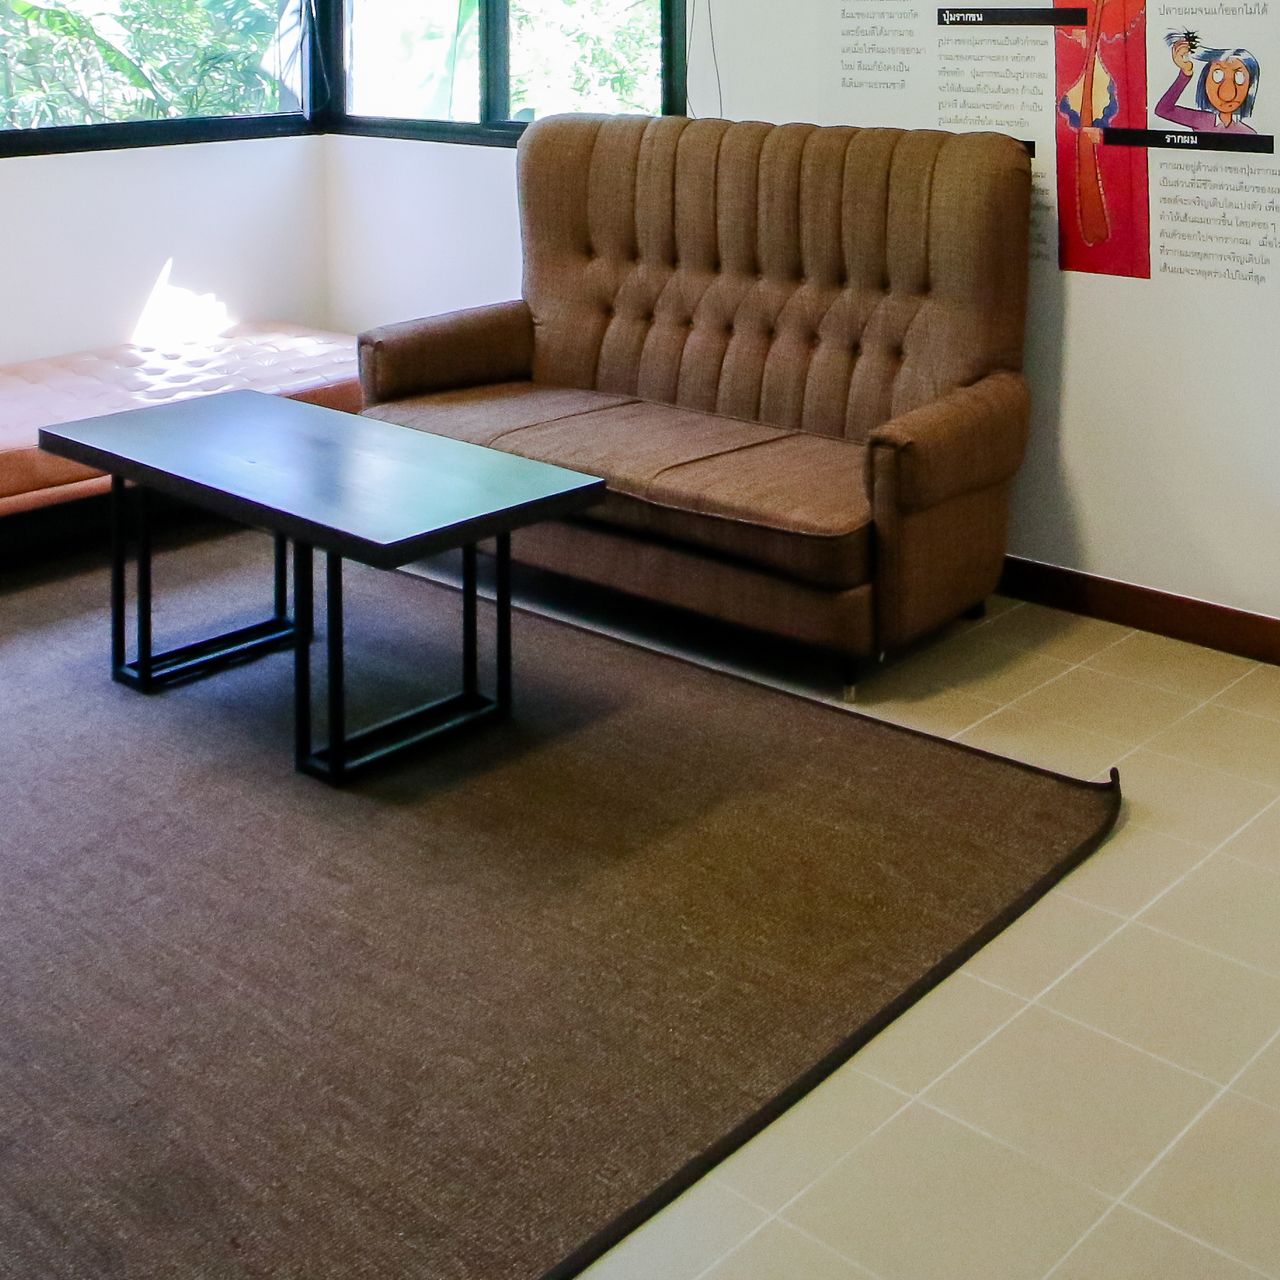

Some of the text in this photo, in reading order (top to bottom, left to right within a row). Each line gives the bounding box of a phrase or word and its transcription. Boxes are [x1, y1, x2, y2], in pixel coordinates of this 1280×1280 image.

[943, 11, 983, 25] ปุ่มรากขน
[1165, 134, 1198, 144] รากผม
